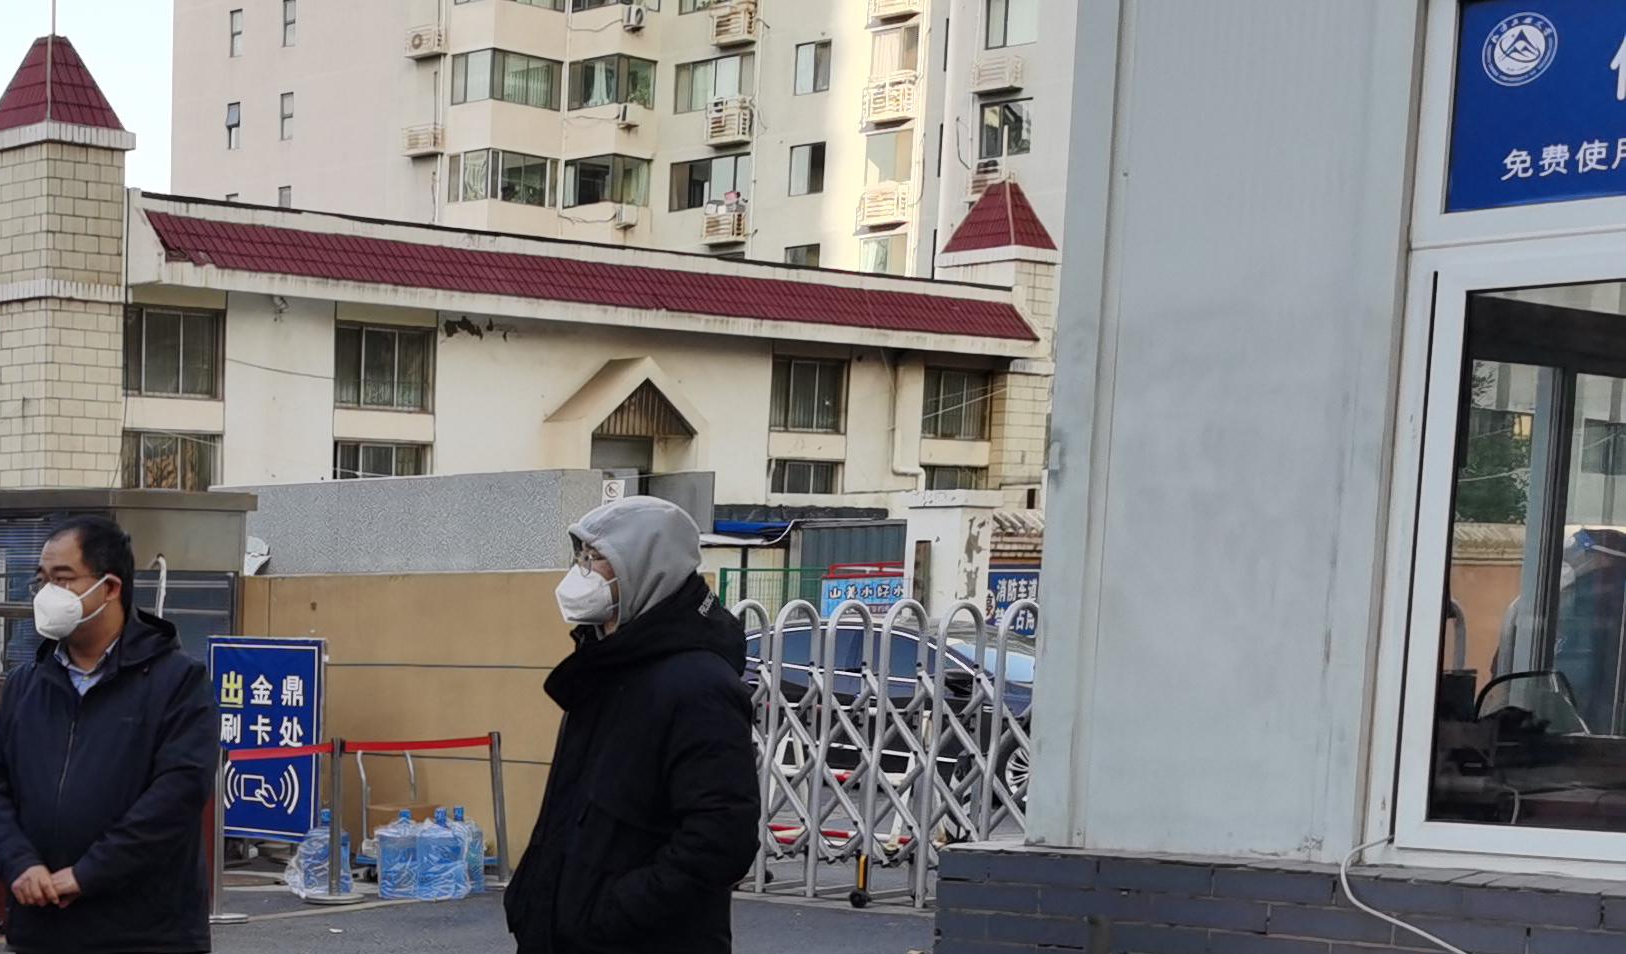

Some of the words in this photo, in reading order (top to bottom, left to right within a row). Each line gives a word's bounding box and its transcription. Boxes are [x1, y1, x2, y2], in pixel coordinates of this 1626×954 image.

[996, 578, 1038, 602] 消防车道
[220, 671, 304, 708] 出金鼎
[220, 713, 304, 748] 刷卡处
